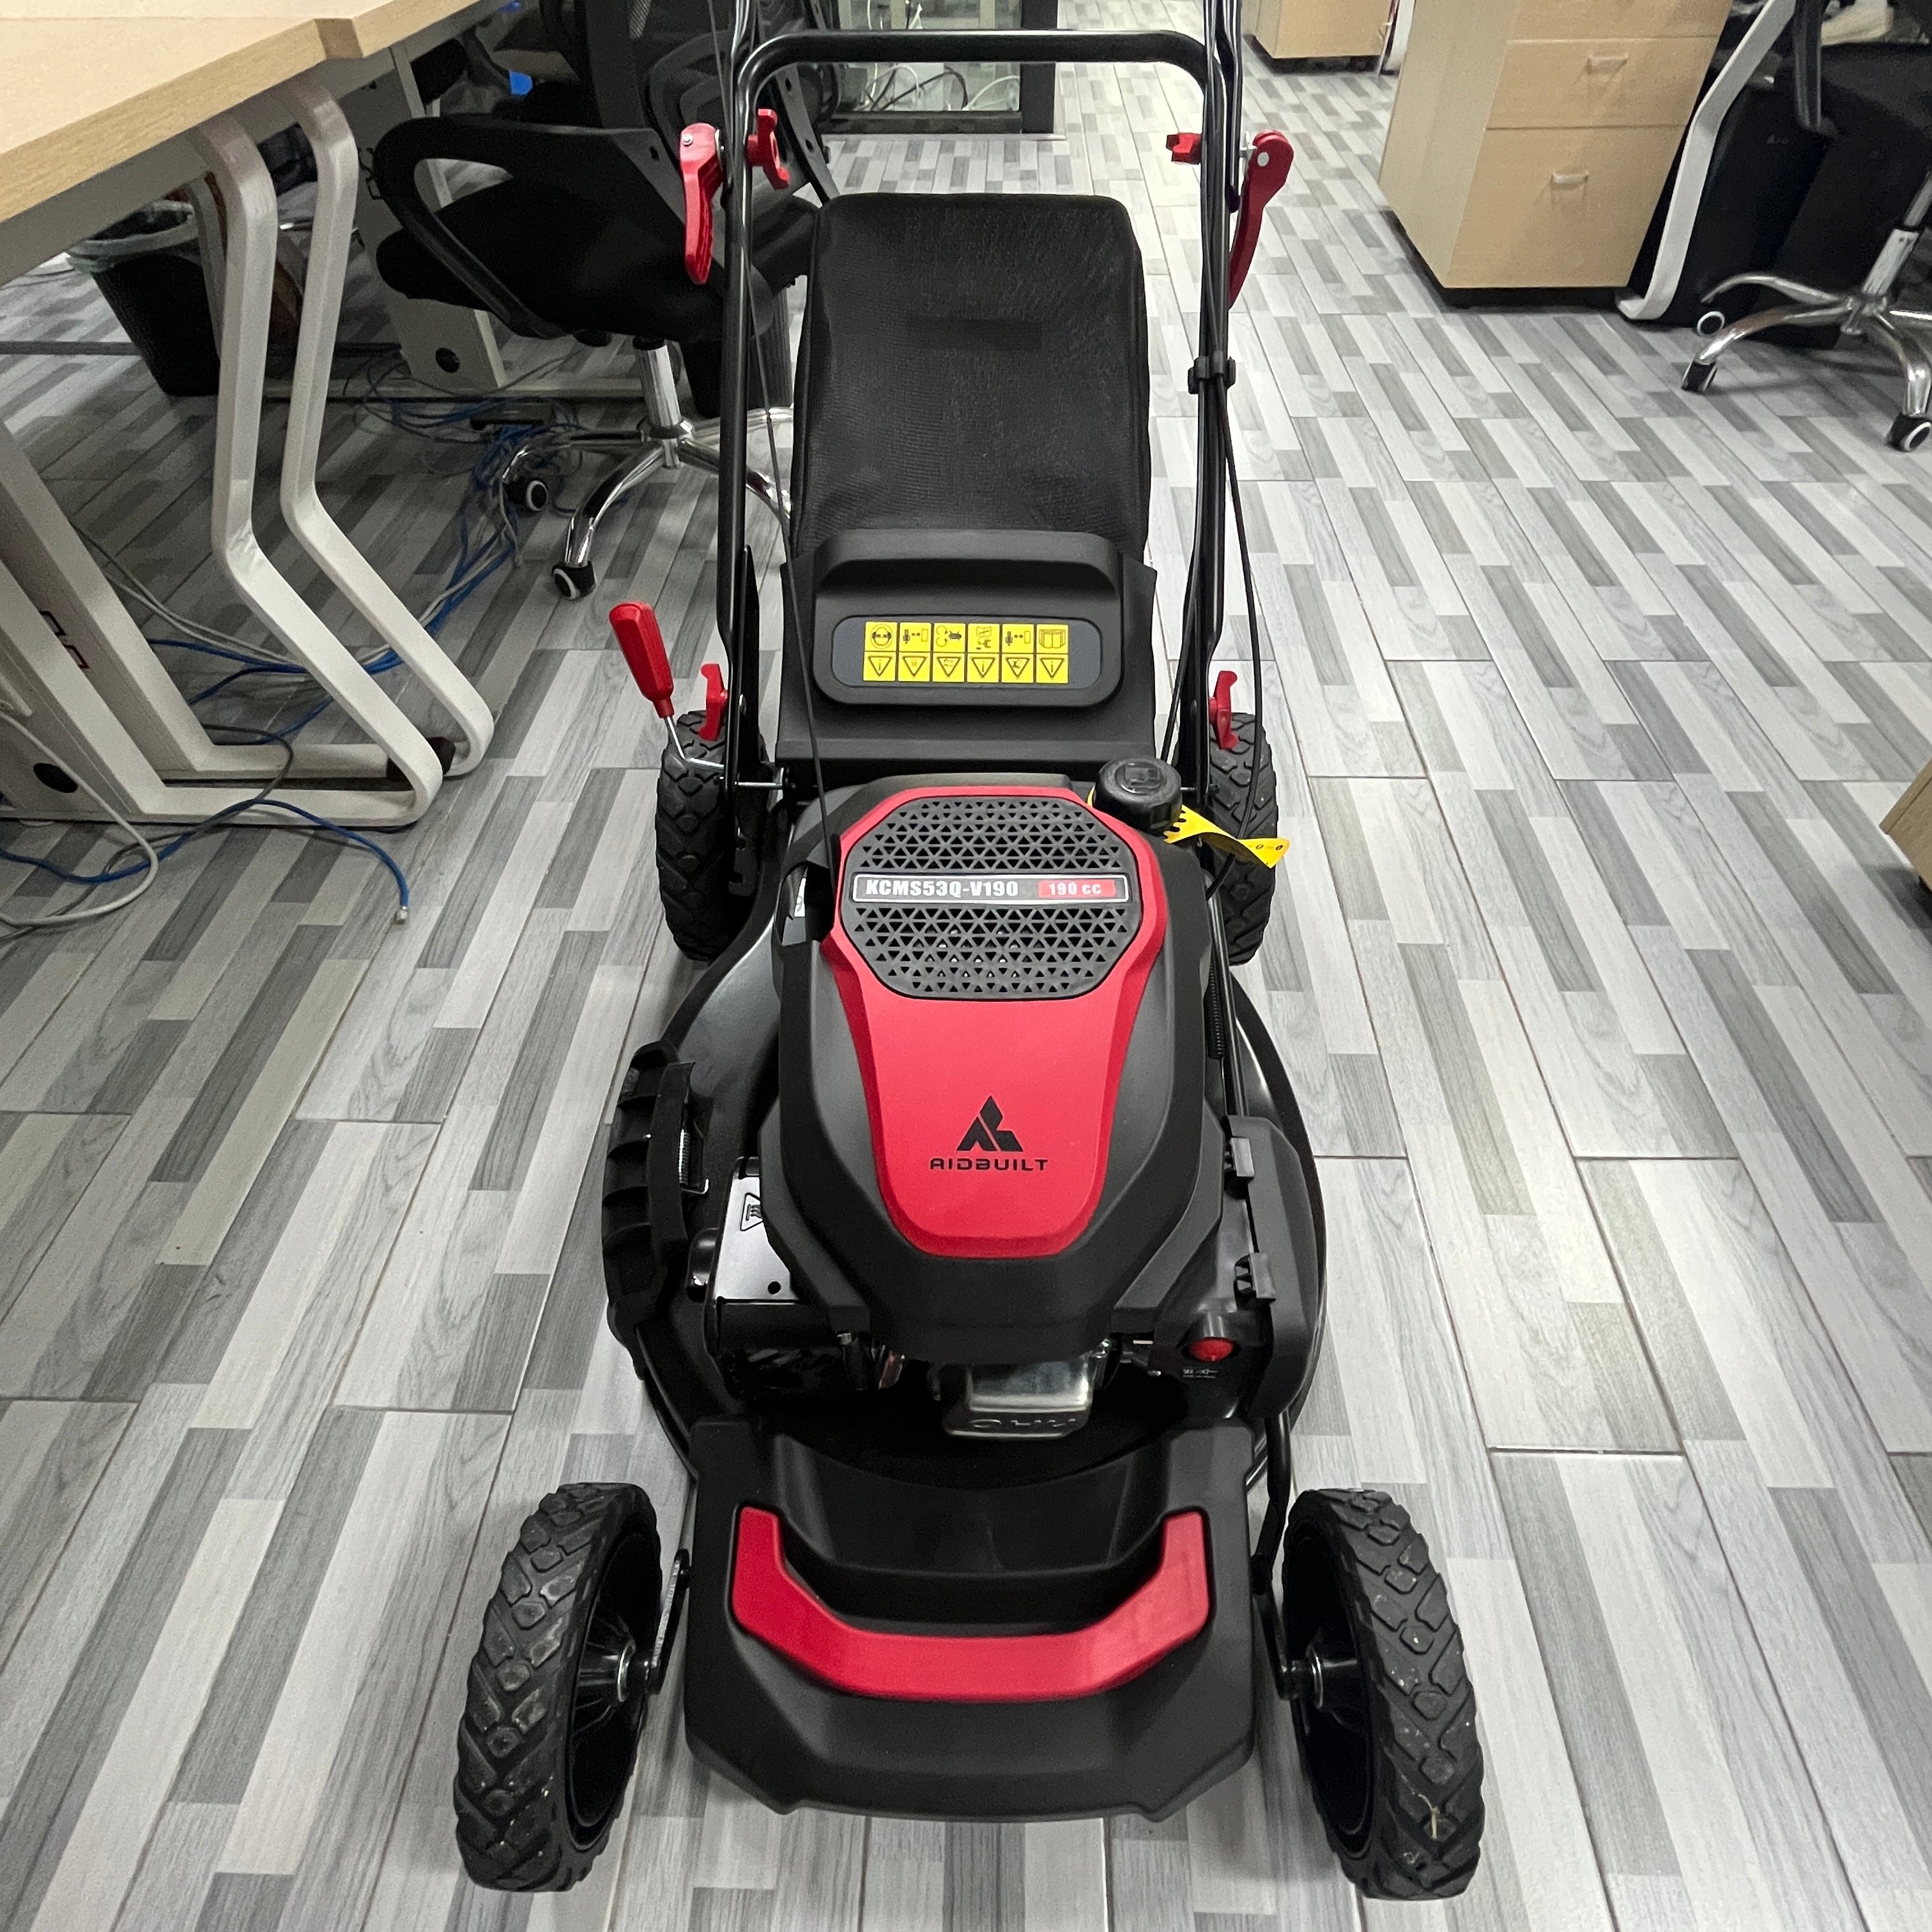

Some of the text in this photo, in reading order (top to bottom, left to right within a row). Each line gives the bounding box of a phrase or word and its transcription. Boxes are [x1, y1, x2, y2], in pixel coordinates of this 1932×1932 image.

[865, 879, 1102, 898] KCMS53Q-V190 190 cc
[930, 1158, 1048, 1171] AIDBUILT
